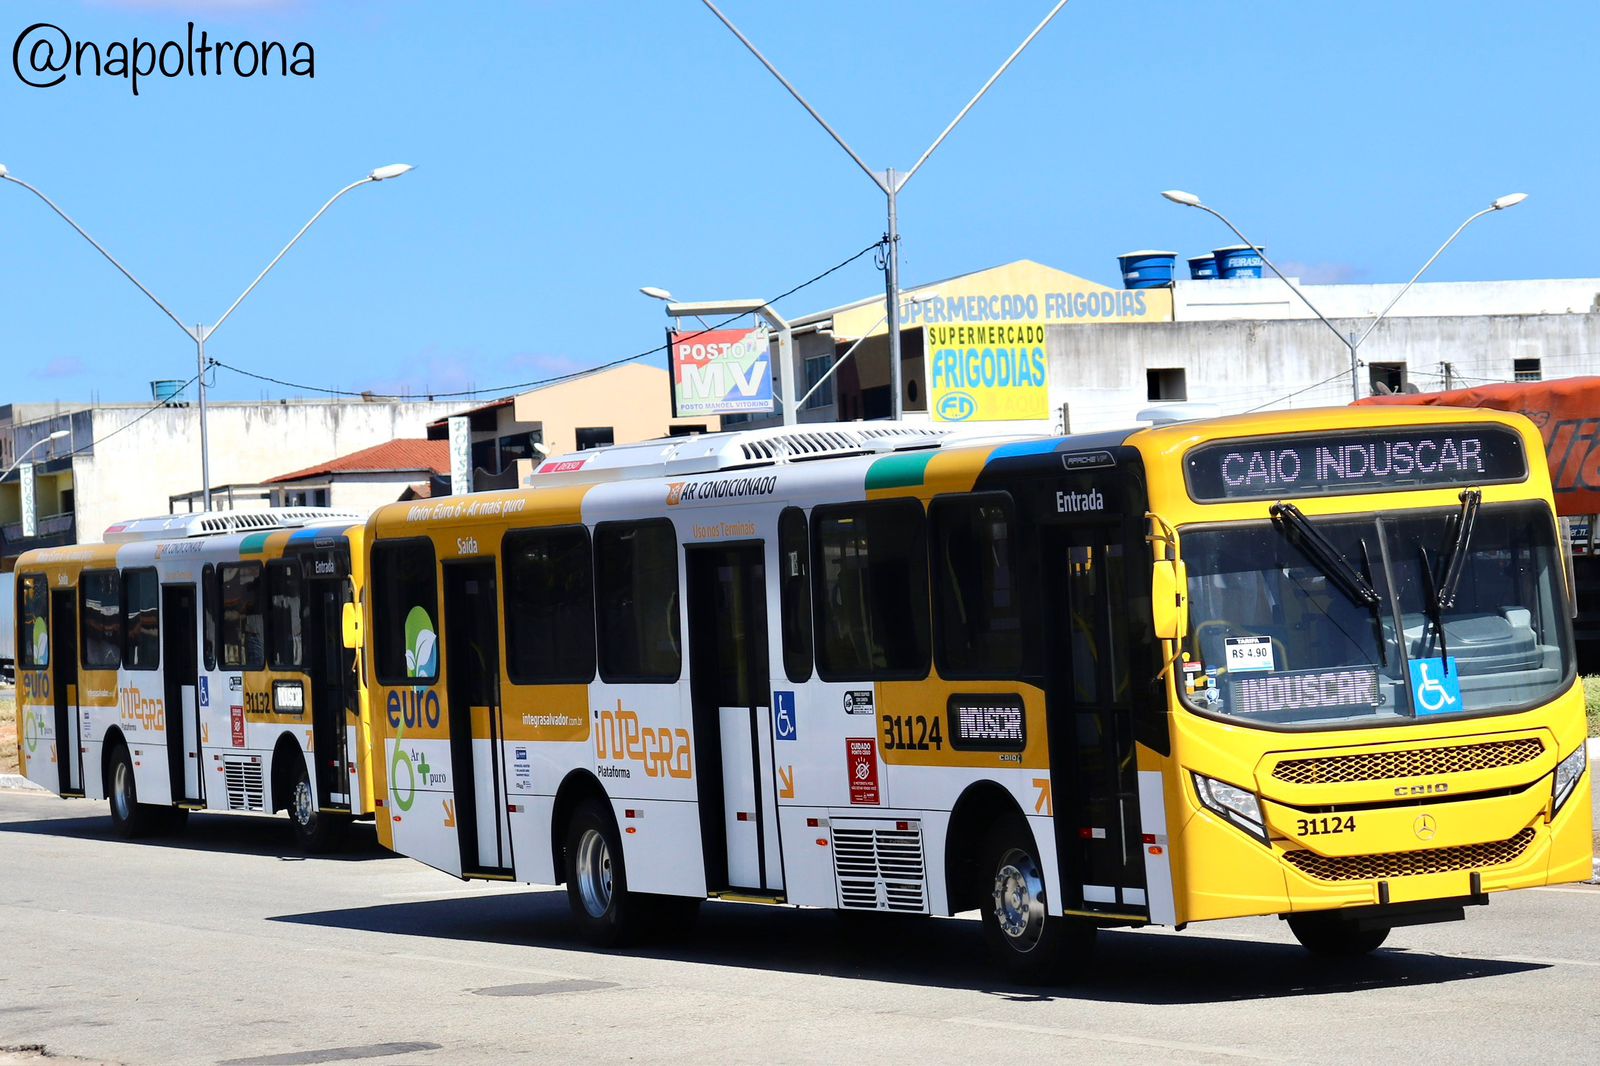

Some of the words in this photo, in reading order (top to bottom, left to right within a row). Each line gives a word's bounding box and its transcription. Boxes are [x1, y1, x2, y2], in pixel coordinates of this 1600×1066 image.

[884, 294, 1039, 324] UPERMERCADO
[1045, 290, 1148, 318] FRIGODIAS
[929, 326, 1044, 346] SUPERMERCADO
[679, 342, 746, 361] POSTO
[680, 360, 768, 400] MV
[932, 347, 1046, 389] FRIGODIAS
[1222, 448, 1301, 487] CAIO
[1316, 438, 1486, 481] INDUSCAR
[681, 482, 698, 500] AR
[698, 475, 777, 499] CONDICIONADO
[407, 506, 432, 522] Motor
[432, 503, 454, 519] Euro
[455, 502, 464, 517] 6
[467, 500, 480, 516] Ar
[480, 499, 501, 514] mais
[502, 498, 526, 517] puro
[1056, 488, 1104, 512] Entrada
[457, 537, 479, 555] Saída
[23, 673, 50, 698] euro
[1242, 669, 1372, 713] INDUSCAR
[245, 692, 271, 714] 31132
[387, 689, 440, 729] euro
[882, 714, 942, 751] 31124
[410, 747, 420, 762] Ar
[850, 742, 871, 750] CUIDADO
[429, 773, 447, 786] puro
[597, 765, 631, 779] Plataforma
[1394, 782, 1449, 797] CAIO
[1296, 815, 1356, 837] 31124
